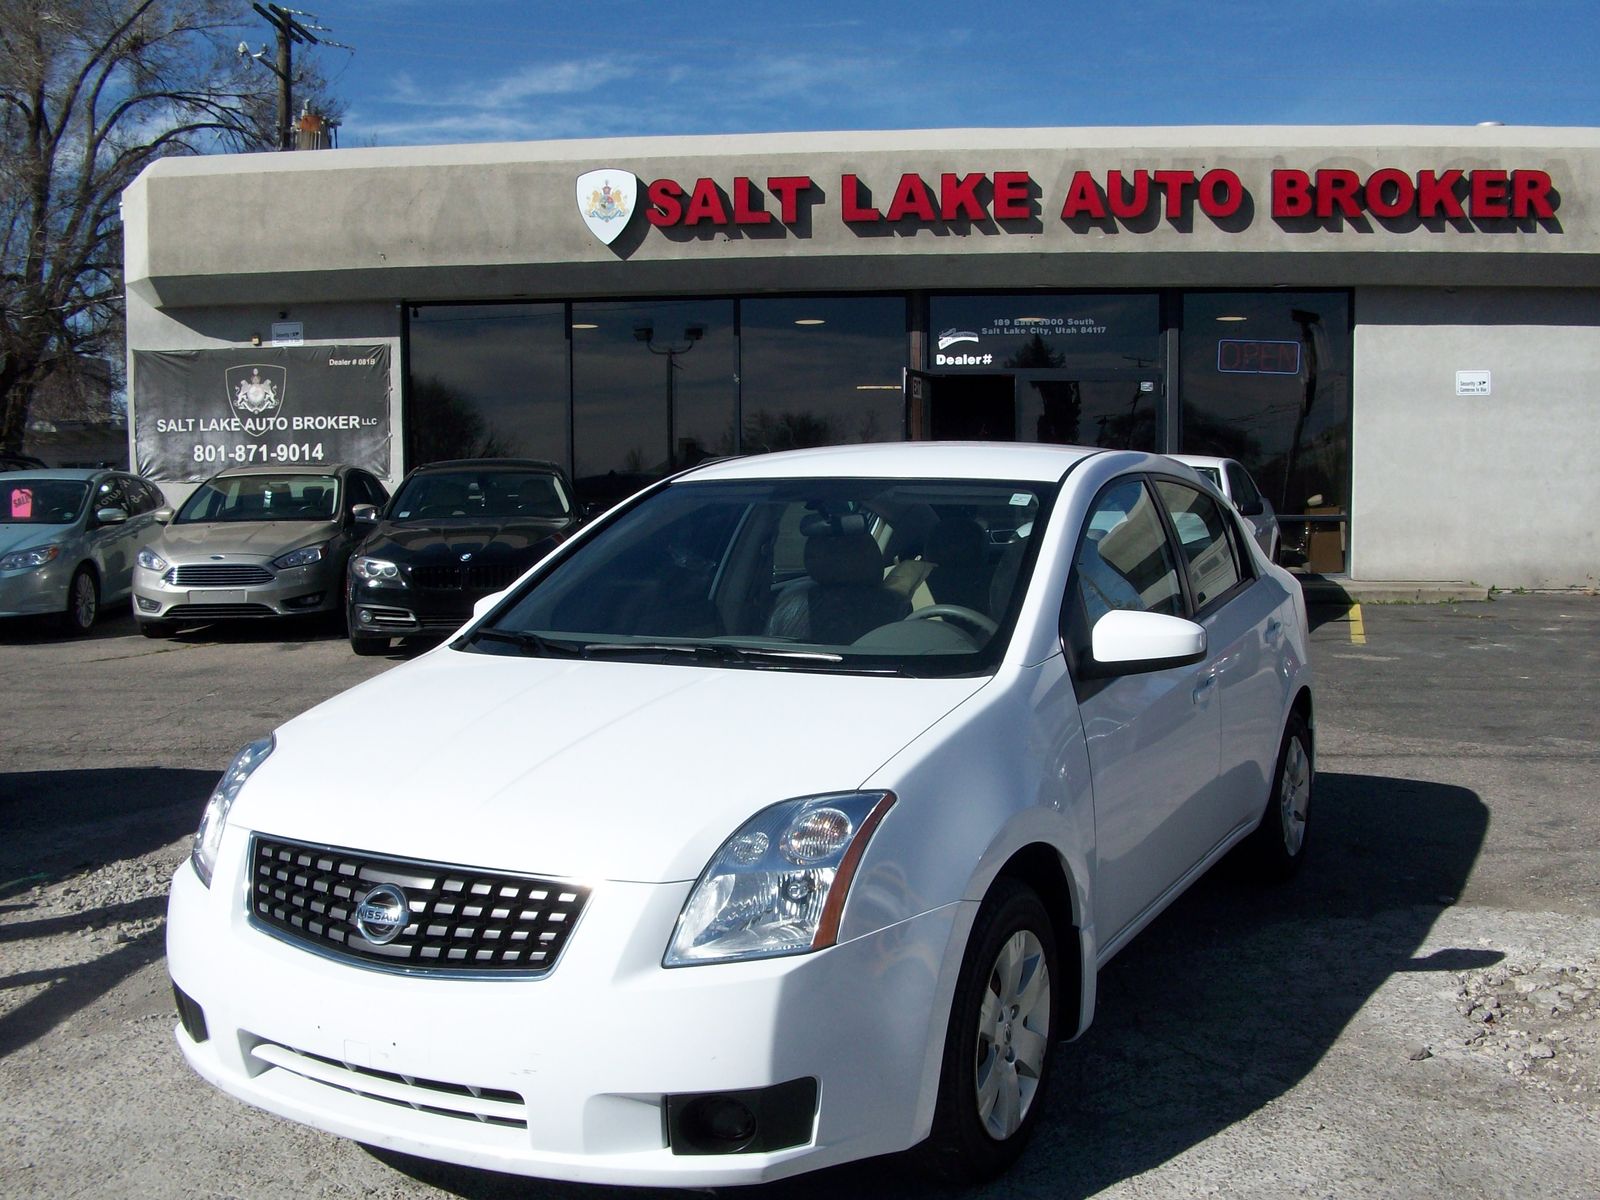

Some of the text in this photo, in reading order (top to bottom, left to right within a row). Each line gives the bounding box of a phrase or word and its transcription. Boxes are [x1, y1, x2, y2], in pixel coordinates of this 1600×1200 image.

[647, 170, 1552, 225] SALT LAKE AUTO BROKER
[993, 318, 1010, 326] 189
[1014, 318, 1035, 326] East
[1067, 318, 1095, 326] South
[981, 326, 1107, 335] Salt Lake City, Utah 84117
[329, 358, 351, 366] Dealer
[936, 354, 993, 365] Dealer#
[1221, 343, 1297, 371] OPEN
[157, 416, 378, 432] SALT LAKE AUTO BROKER LLC
[193, 443, 324, 462] 801-871-9014
[359, 907, 400, 922] NISSAN
